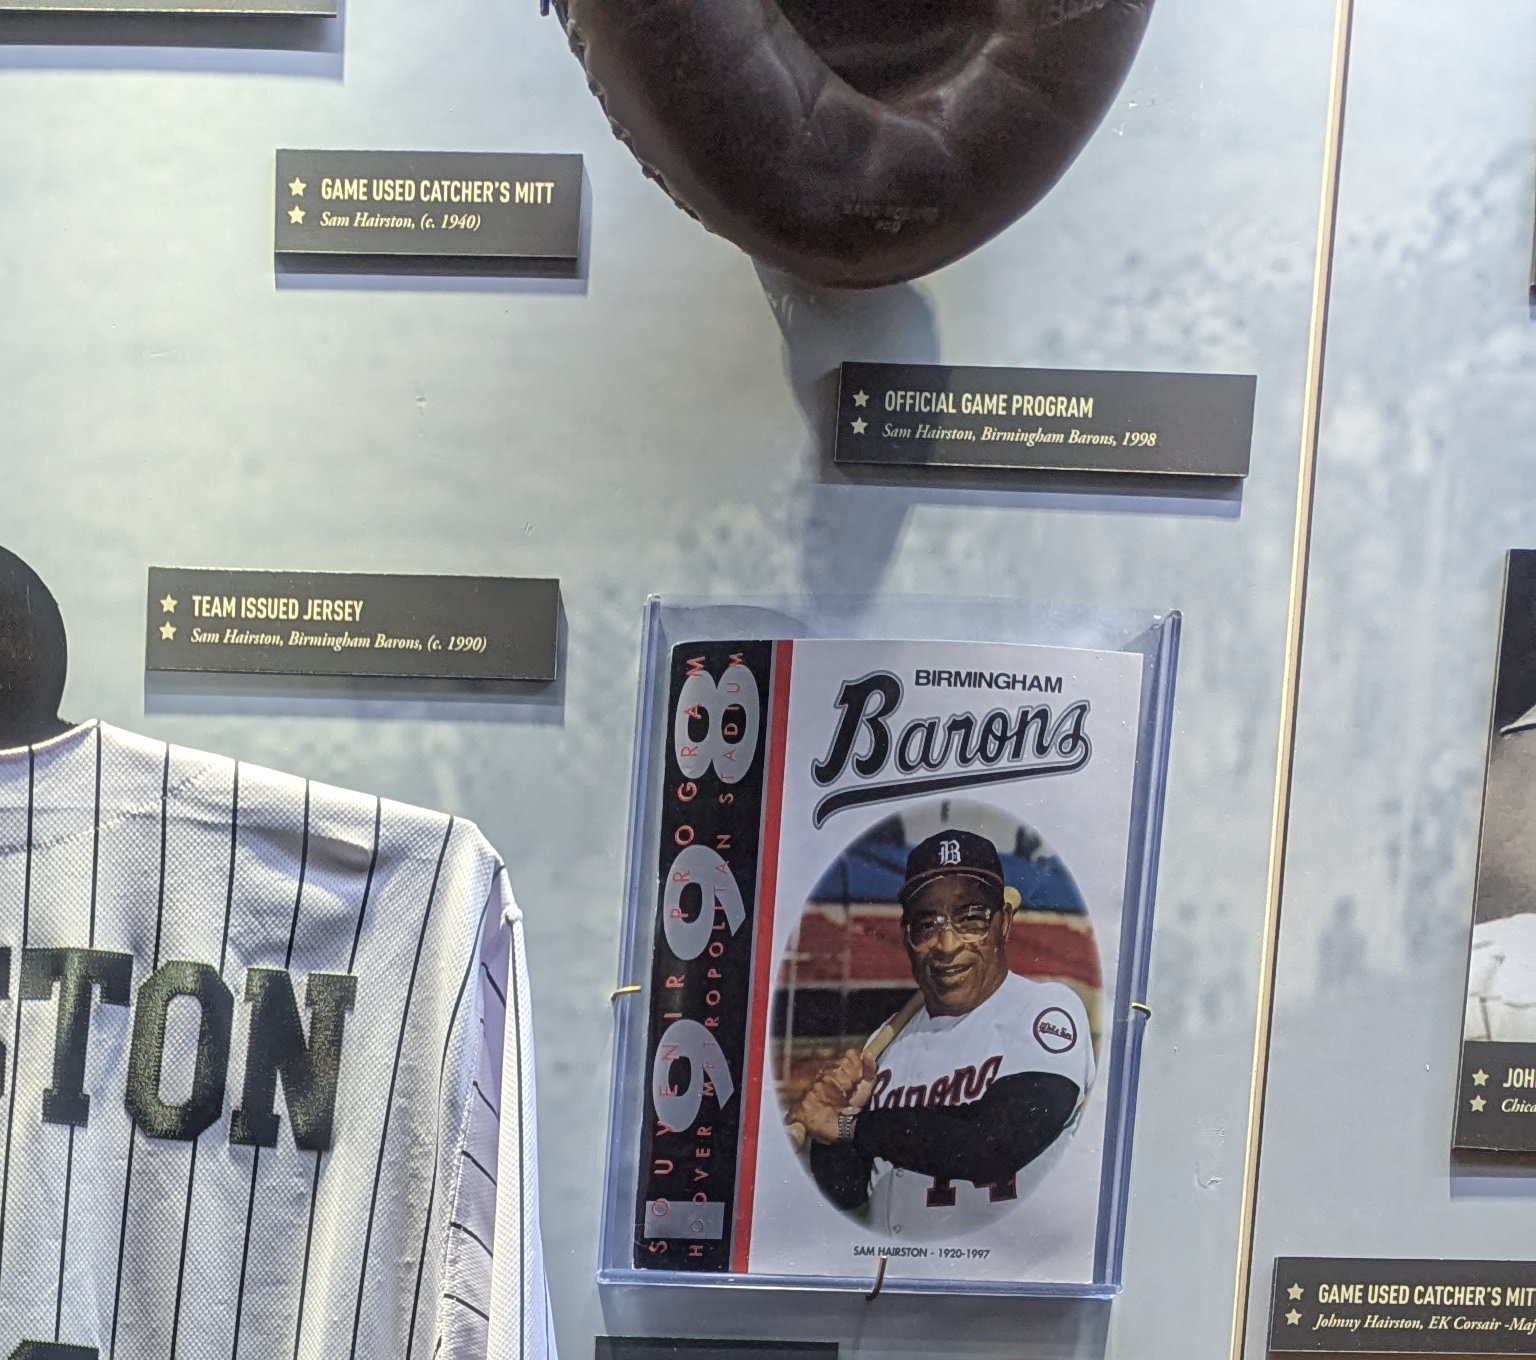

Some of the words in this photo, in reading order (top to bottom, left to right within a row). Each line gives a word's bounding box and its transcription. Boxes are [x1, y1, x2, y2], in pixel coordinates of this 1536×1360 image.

[321, 178, 367, 199] GAME
[372, 179, 415, 201] USED
[420, 181, 510, 203] CATCHER'S
[515, 182, 554, 204] MITT
[320, 212, 350, 227] Sam
[353, 212, 415, 230] Hairston,
[421, 213, 435, 230] (c.
[441, 214, 481, 231] 1940)
[885, 390, 956, 414] OFFICIAL
[962, 393, 1007, 416] GAME
[1012, 395, 1093, 418] PROGRAM
[882, 423, 911, 439] Sam
[915, 424, 976, 442] Hairston,
[981, 426, 1064, 448] Birmingham
[1068, 428, 1117, 446] Barons,
[1122, 431, 1157, 447] 1998
[192, 595, 236, 618] TEAM
[241, 597, 299, 620] ISSUED
[302, 599, 363, 622] JERSEY
[190, 628, 219, 643] Sam
[223, 628, 285, 648] Hairston,
[288, 631, 371, 652] Birmingham
[375, 634, 422, 652] Barons,
[427, 636, 442, 652] (c.
[447, 636, 487, 654] 1990)
[915, 669, 1063, 694] BIRMINGHAM
[811, 669, 1092, 829] Barons
[669, 655, 706, 920] PROGRAM
[1503, 1067, 1536, 1088] JOH
[853, 1245, 875, 1257] SAM
[878, 1246, 928, 1258] HAIRSTON
[939, 1248, 991, 1259] 1920-1997
[1319, 1284, 1363, 1303] GAME
[1367, 1285, 1409, 1304] USED
[1414, 1286, 1502, 1306] CATCHER'S
[1506, 1287, 1536, 1307] MIT
[1312, 1314, 1361, 1332] Johnny
[1364, 1315, 1424, 1330] Hairston,
[1428, 1316, 1450, 1329] EK
[1453, 1317, 1502, 1331] Corsair
